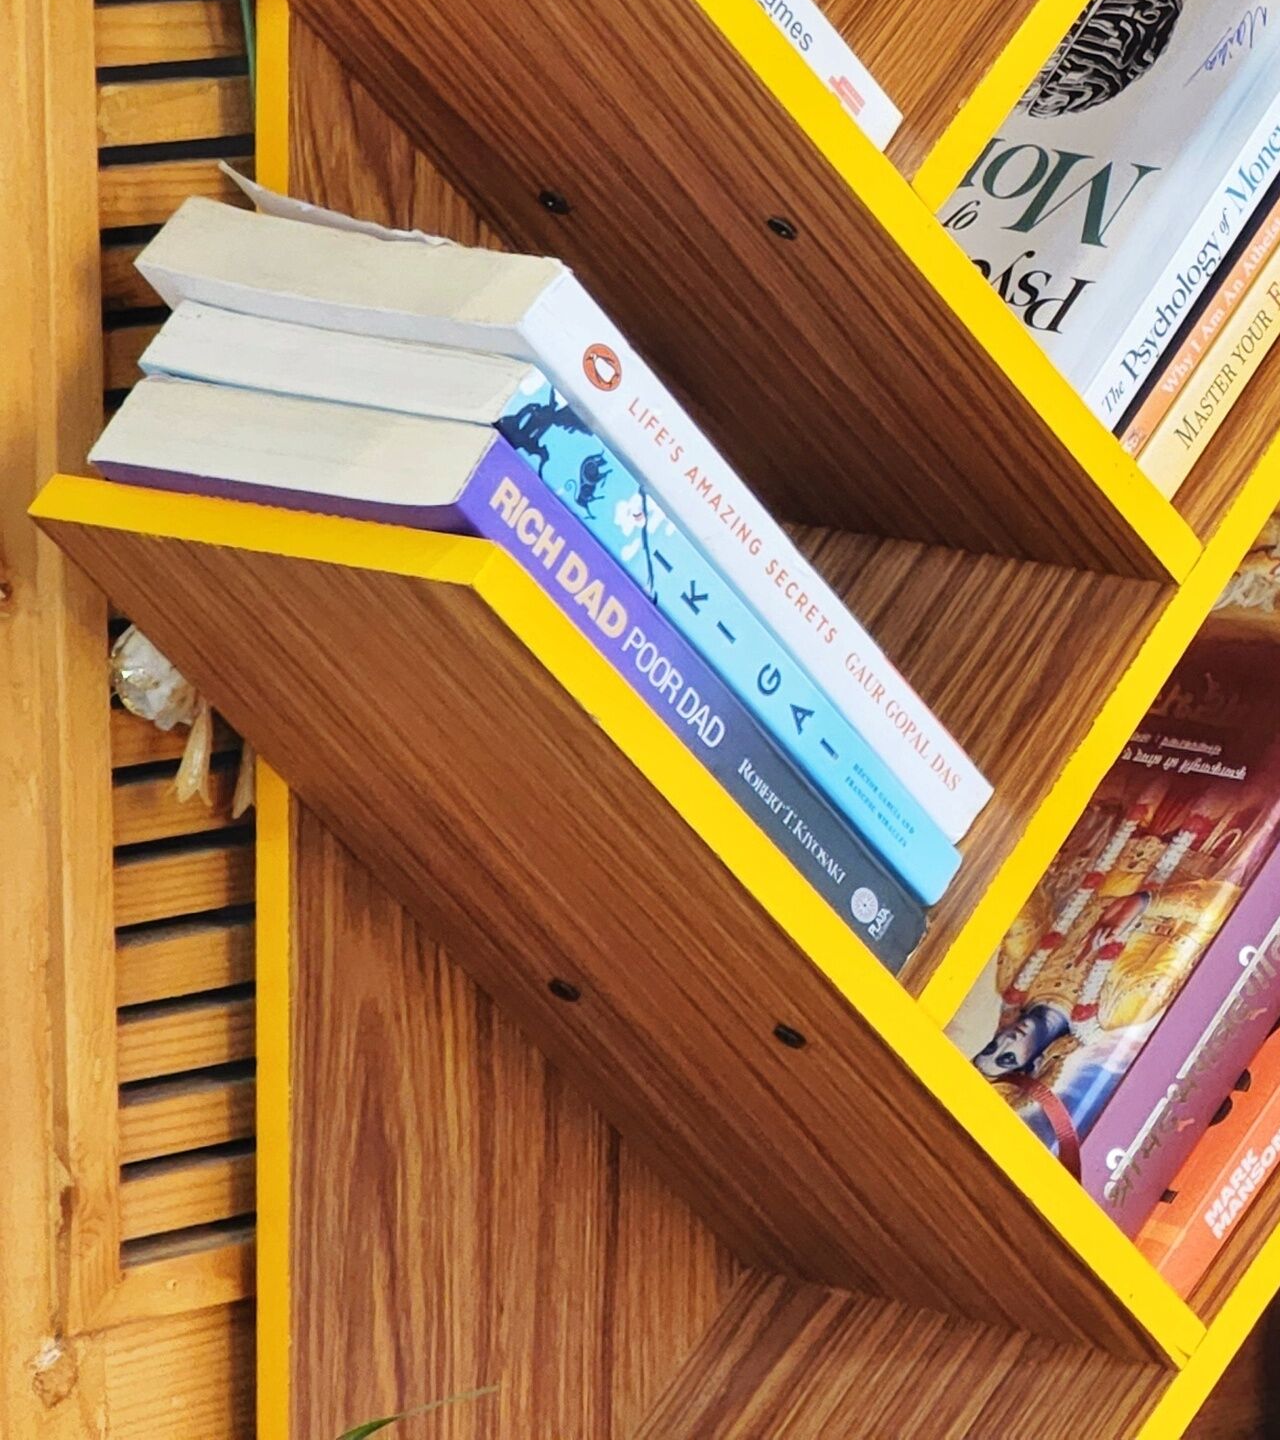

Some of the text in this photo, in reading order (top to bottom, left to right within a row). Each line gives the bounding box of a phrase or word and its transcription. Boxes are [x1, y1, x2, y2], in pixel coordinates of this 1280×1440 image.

[1101, 384, 1126, 417] The
[1121, 231, 1225, 383] Psychology
[1219, 207, 1231, 234] of
[1160, 356, 1196, 396] Why
[1190, 338, 1202, 353] I
[1201, 308, 1226, 339] Am
[1223, 280, 1244, 307] An
[1173, 364, 1238, 451] MASTER
[1231, 310, 1273, 366] YOUR
[628, 397, 839, 644] LIFE'S AMAZING SECRETS
[489, 477, 725, 748] RICH DAD POOR DAD
[845, 652, 962, 792] GAUR GOPAL DAS
[737, 758, 847, 885] ROBERT T. KIYOSAKI
[868, 907, 892, 940] PLATA
[1204, 1147, 1259, 1227] MARK
